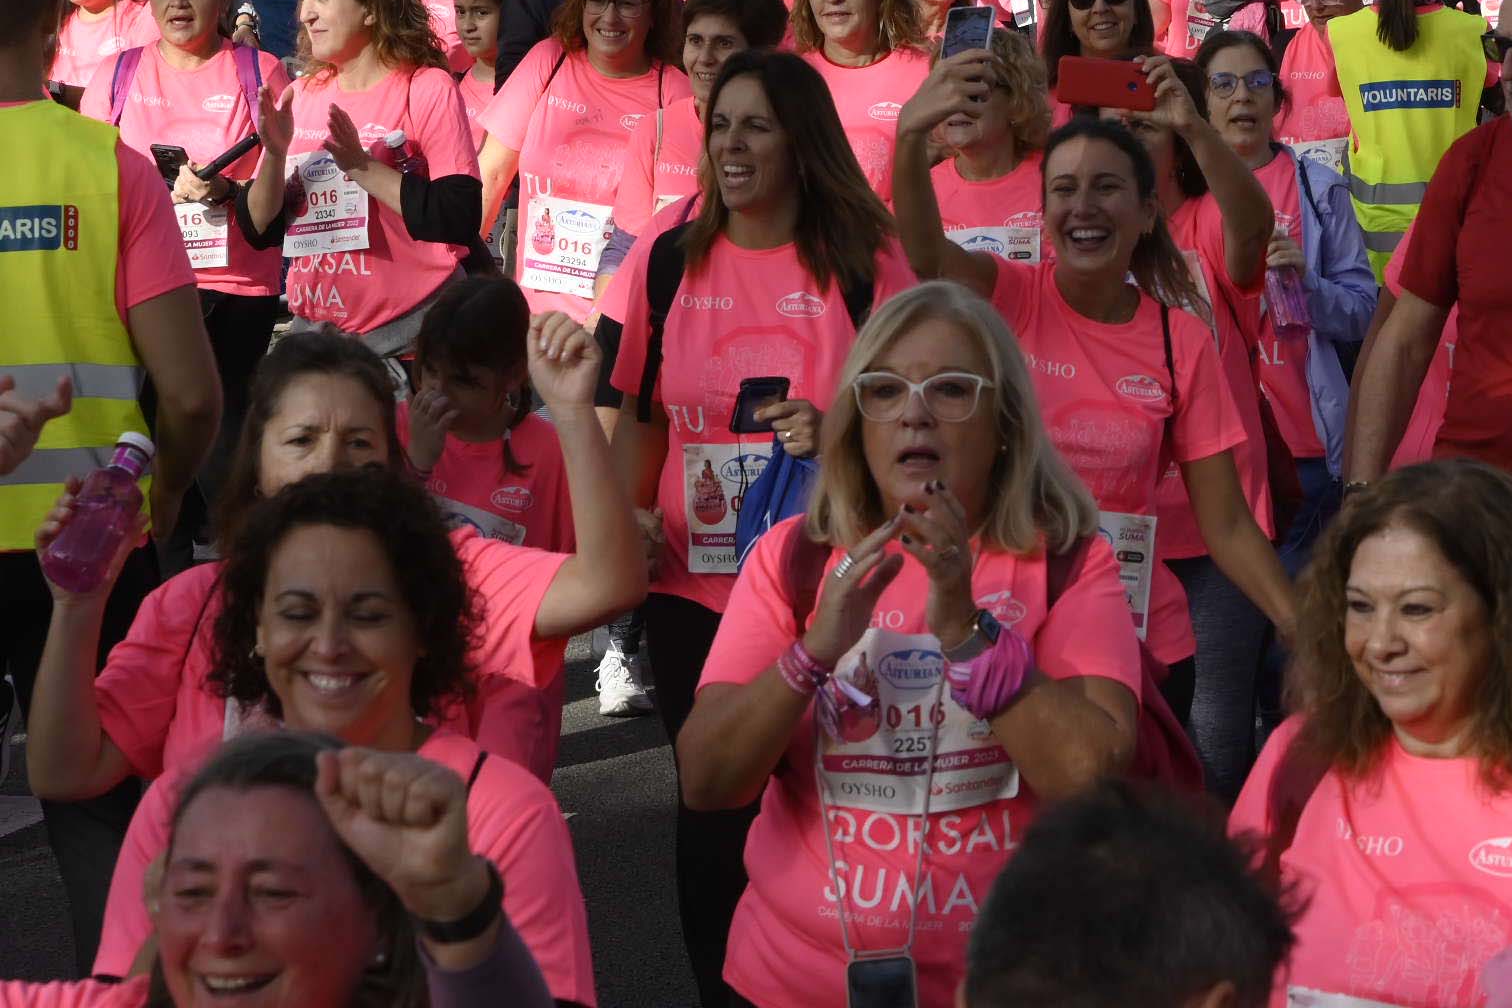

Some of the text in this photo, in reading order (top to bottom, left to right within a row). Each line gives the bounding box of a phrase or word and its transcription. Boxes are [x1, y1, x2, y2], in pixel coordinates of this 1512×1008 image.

[1290, 69, 1326, 81] OYSHO
[548, 94, 587, 115] OYSHO
[1362, 87, 1453, 105] VOLUNTARIS
[525, 172, 553, 198] TU
[310, 189, 338, 207] 016
[558, 238, 592, 256] 016
[680, 293, 733, 311] OYSHO
[667, 404, 706, 434] TU
[886, 702, 945, 730] 016
[842, 758, 894, 772] CARRERA
[841, 781, 896, 800] OYSHO
[828, 807, 1019, 855] DORSAL
[823, 858, 981, 916] SUMA
